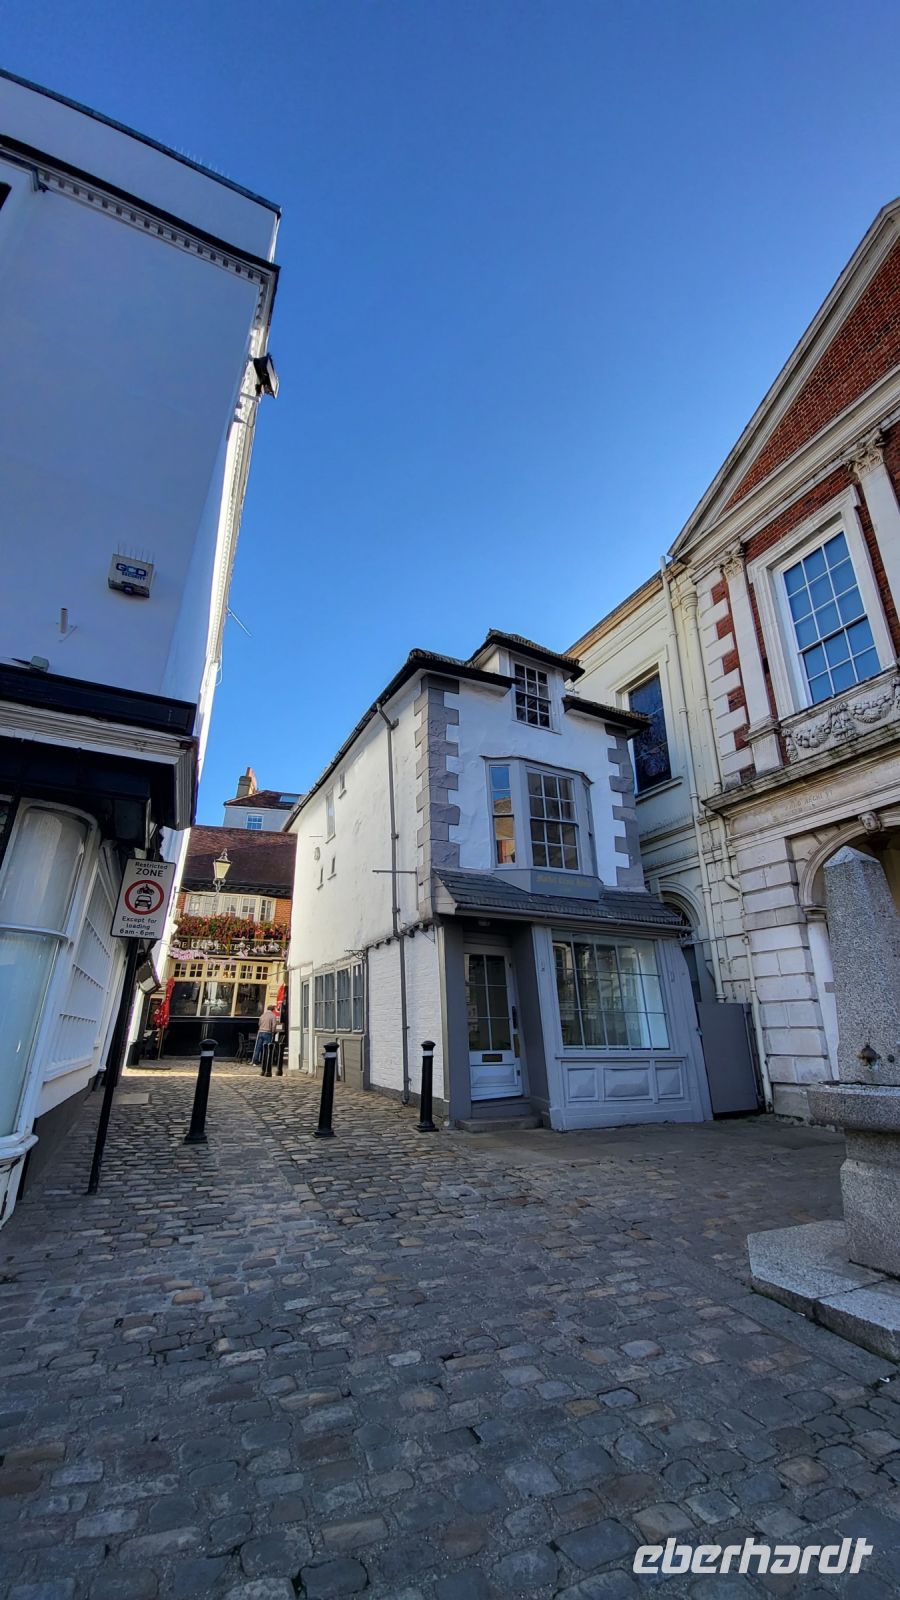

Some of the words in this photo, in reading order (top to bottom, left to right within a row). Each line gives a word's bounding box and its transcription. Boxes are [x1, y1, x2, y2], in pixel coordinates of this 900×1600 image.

[135, 861, 168, 870] Restricted
[135, 867, 164, 878] ZONE
[122, 915, 145, 923] Except
